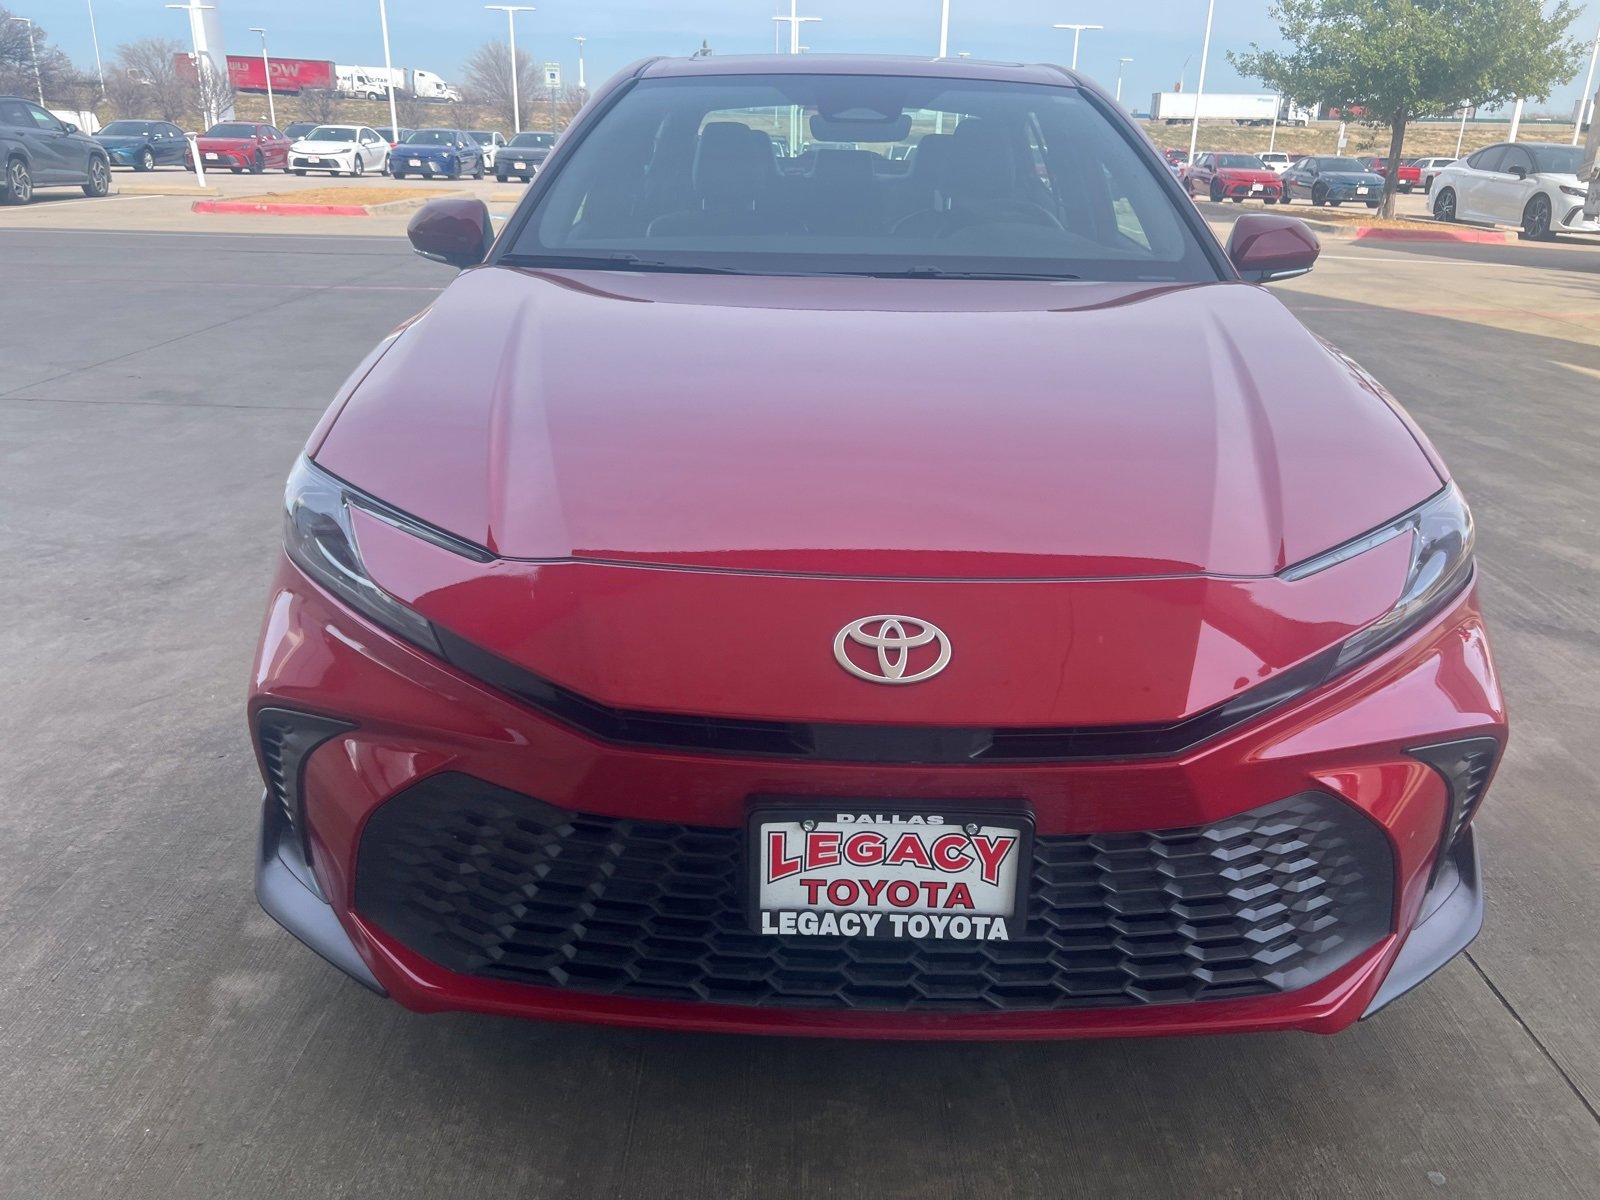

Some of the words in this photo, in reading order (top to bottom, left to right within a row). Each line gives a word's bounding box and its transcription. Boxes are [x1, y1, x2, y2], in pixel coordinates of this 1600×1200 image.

[836, 813, 944, 825] DALLAS
[768, 830, 1017, 886] LEGACY
[800, 878, 975, 909] TOYOTA
[761, 911, 882, 936] LEGACY
[889, 913, 1009, 940] TOYOTA
